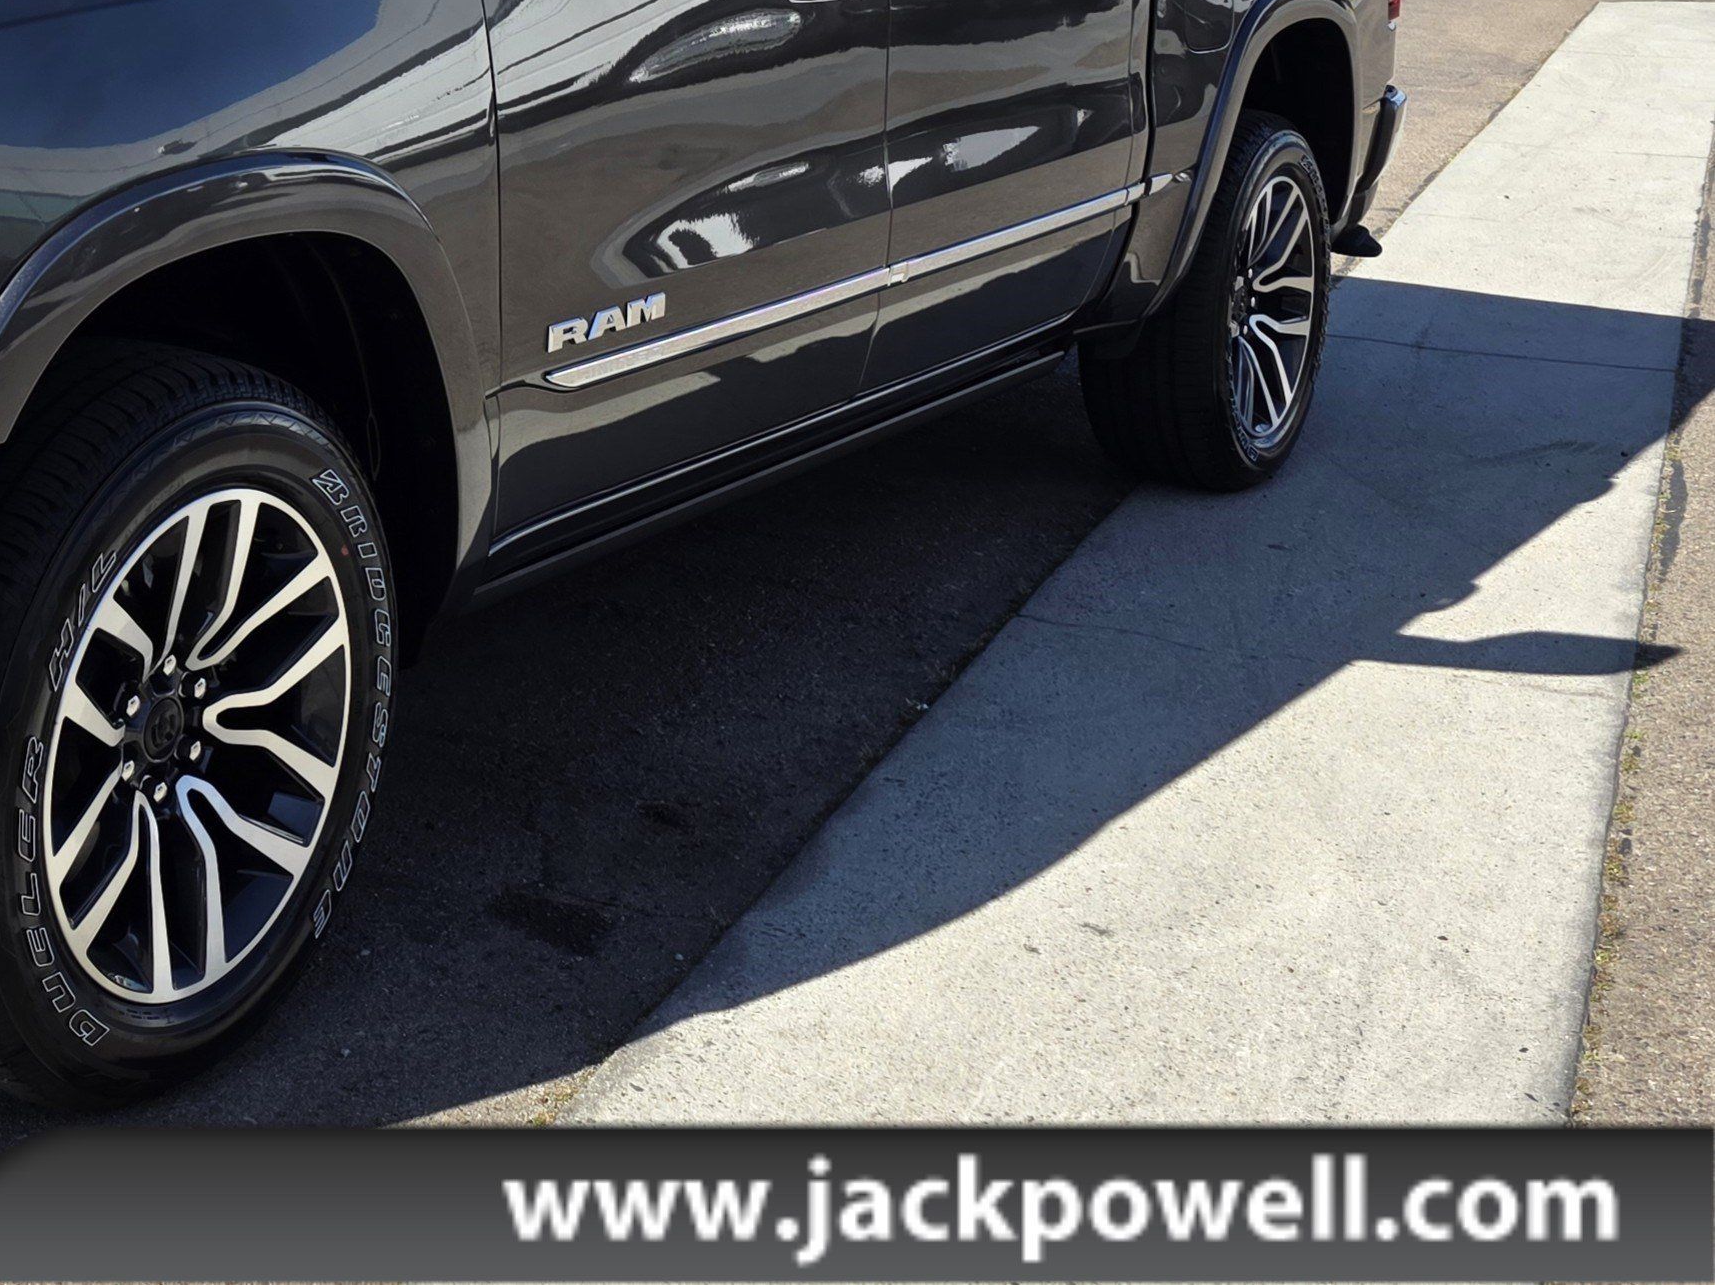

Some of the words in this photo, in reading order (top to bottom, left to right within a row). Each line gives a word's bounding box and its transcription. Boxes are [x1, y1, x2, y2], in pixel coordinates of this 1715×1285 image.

[547, 291, 666, 354] RAM
[311, 468, 392, 940] BRIDGESTONE
[17, 735, 111, 1048] DUELER
